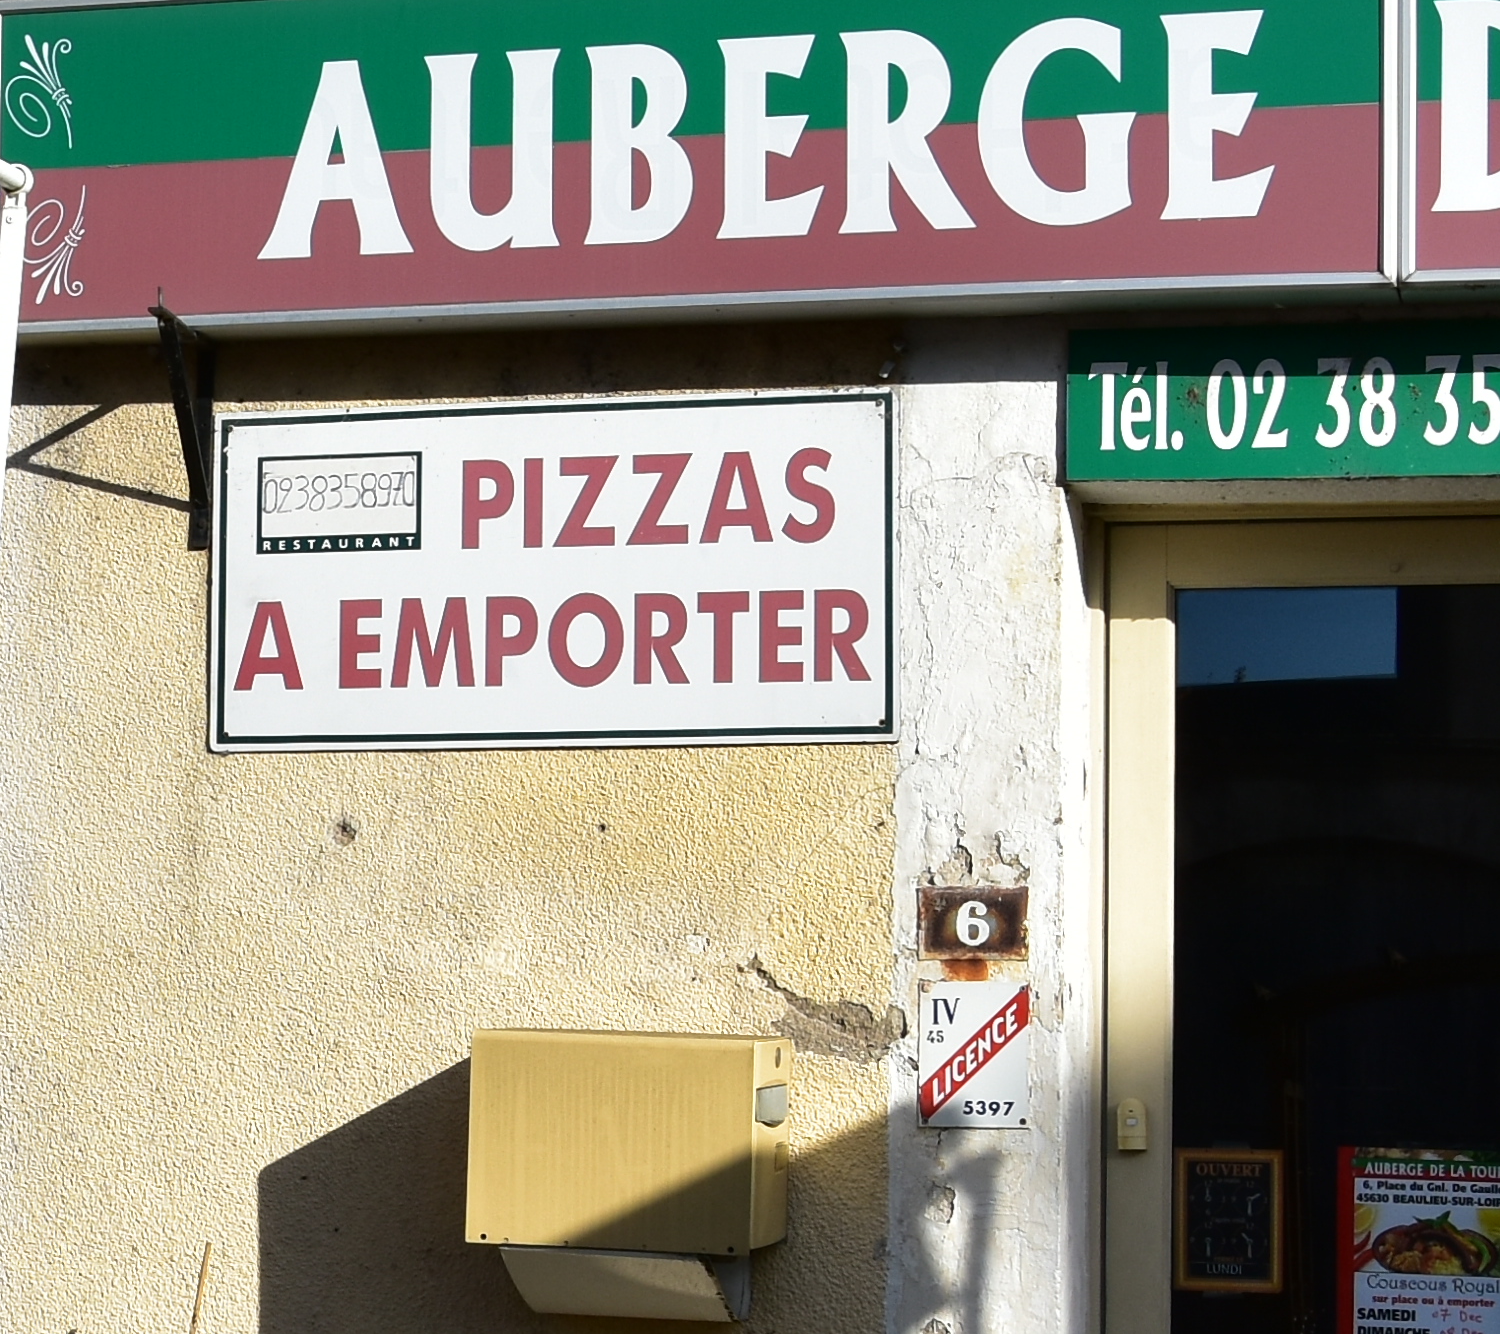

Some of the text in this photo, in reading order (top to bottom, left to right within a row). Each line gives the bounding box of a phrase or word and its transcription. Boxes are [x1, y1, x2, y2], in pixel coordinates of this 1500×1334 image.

[256, 8, 1278, 261] AUBERGE
[1088, 359, 1185, 453] Tél.
[1205, 357, 1290, 450] 02
[1315, 356, 1397, 449] 38
[459, 446, 837, 551] PIZZAS
[262, 536, 416, 552] RESTAURANT
[233, 585, 874, 694] A EMPORTER
[955, 900, 991, 947] 6
[931, 997, 961, 1026] IV
[926, 1030, 945, 1044] 45
[931, 1002, 1020, 1108] LICENCE
[962, 1100, 1016, 1117] 5397
[1195, 1163, 1263, 1177] OUVERT
[1364, 1161, 1424, 1177] AUBERGE
[1429, 1163, 1447, 1178] DE
[1450, 1164, 1467, 1178] LA
[1377, 1180, 1407, 1192] Place
[1409, 1181, 1424, 1192] du
[1452, 1183, 1467, 1194] De
[1356, 1192, 1389, 1204] 45630
[1206, 1263, 1243, 1275] LUNDI
[1366, 1273, 1500, 1297] Couscous Royal
[1371, 1295, 1389, 1304] sur
[1391, 1294, 1419, 1306] place
[1421, 1296, 1435, 1305] ou
[1446, 1297, 1496, 1309] emporter
[1356, 1307, 1417, 1322] SAMEDI
